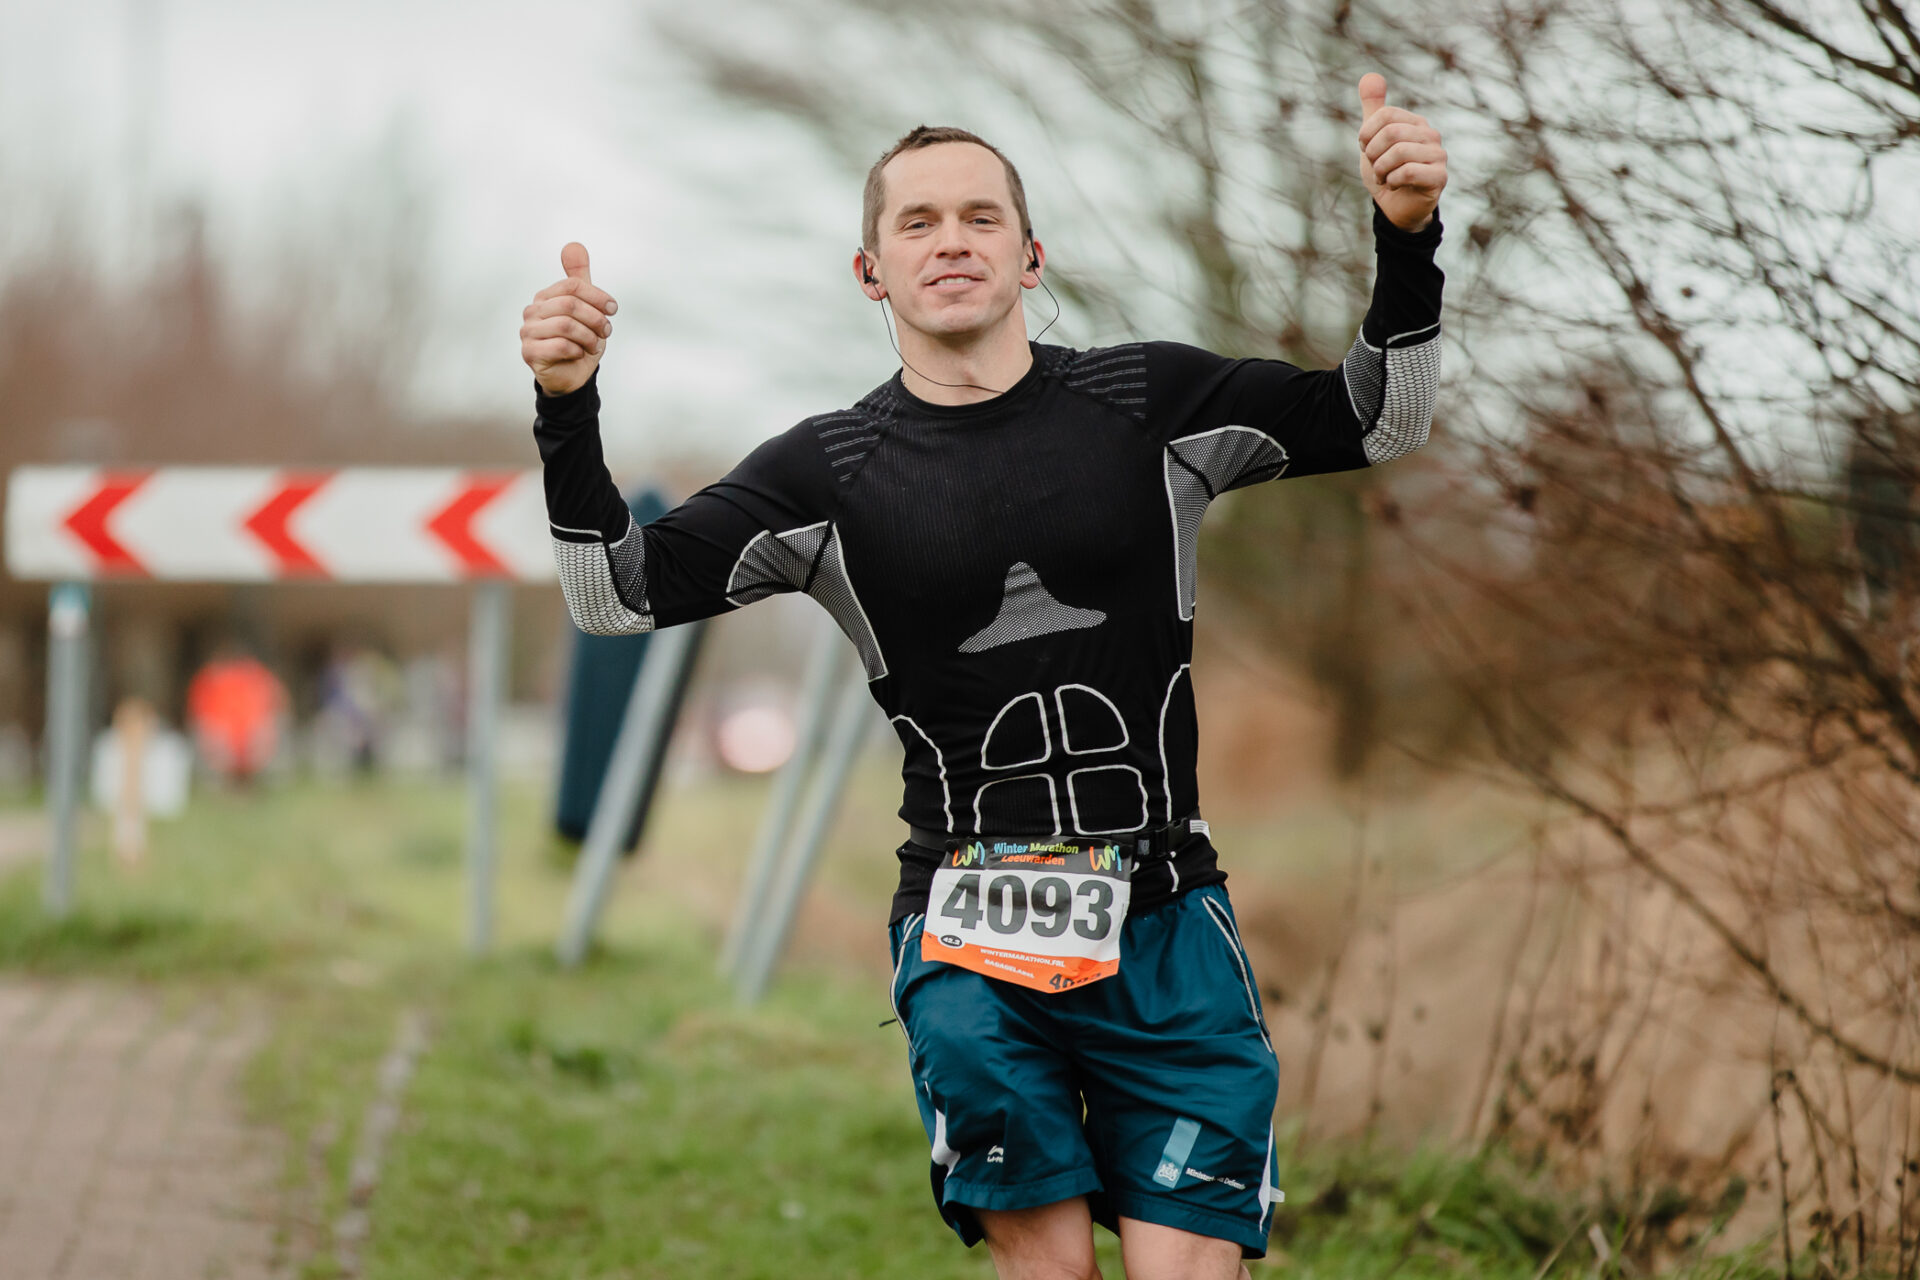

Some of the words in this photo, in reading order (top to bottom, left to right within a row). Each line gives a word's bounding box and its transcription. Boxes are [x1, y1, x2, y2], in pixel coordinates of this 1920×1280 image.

[993, 842, 1028, 854] Winter
[1029, 842, 1079, 855] Marathon
[1001, 854, 1065, 866] Leeuwarden
[940, 873, 1114, 941] 4093
[980, 948, 1066, 968] WINTERMARATHON.FRL
